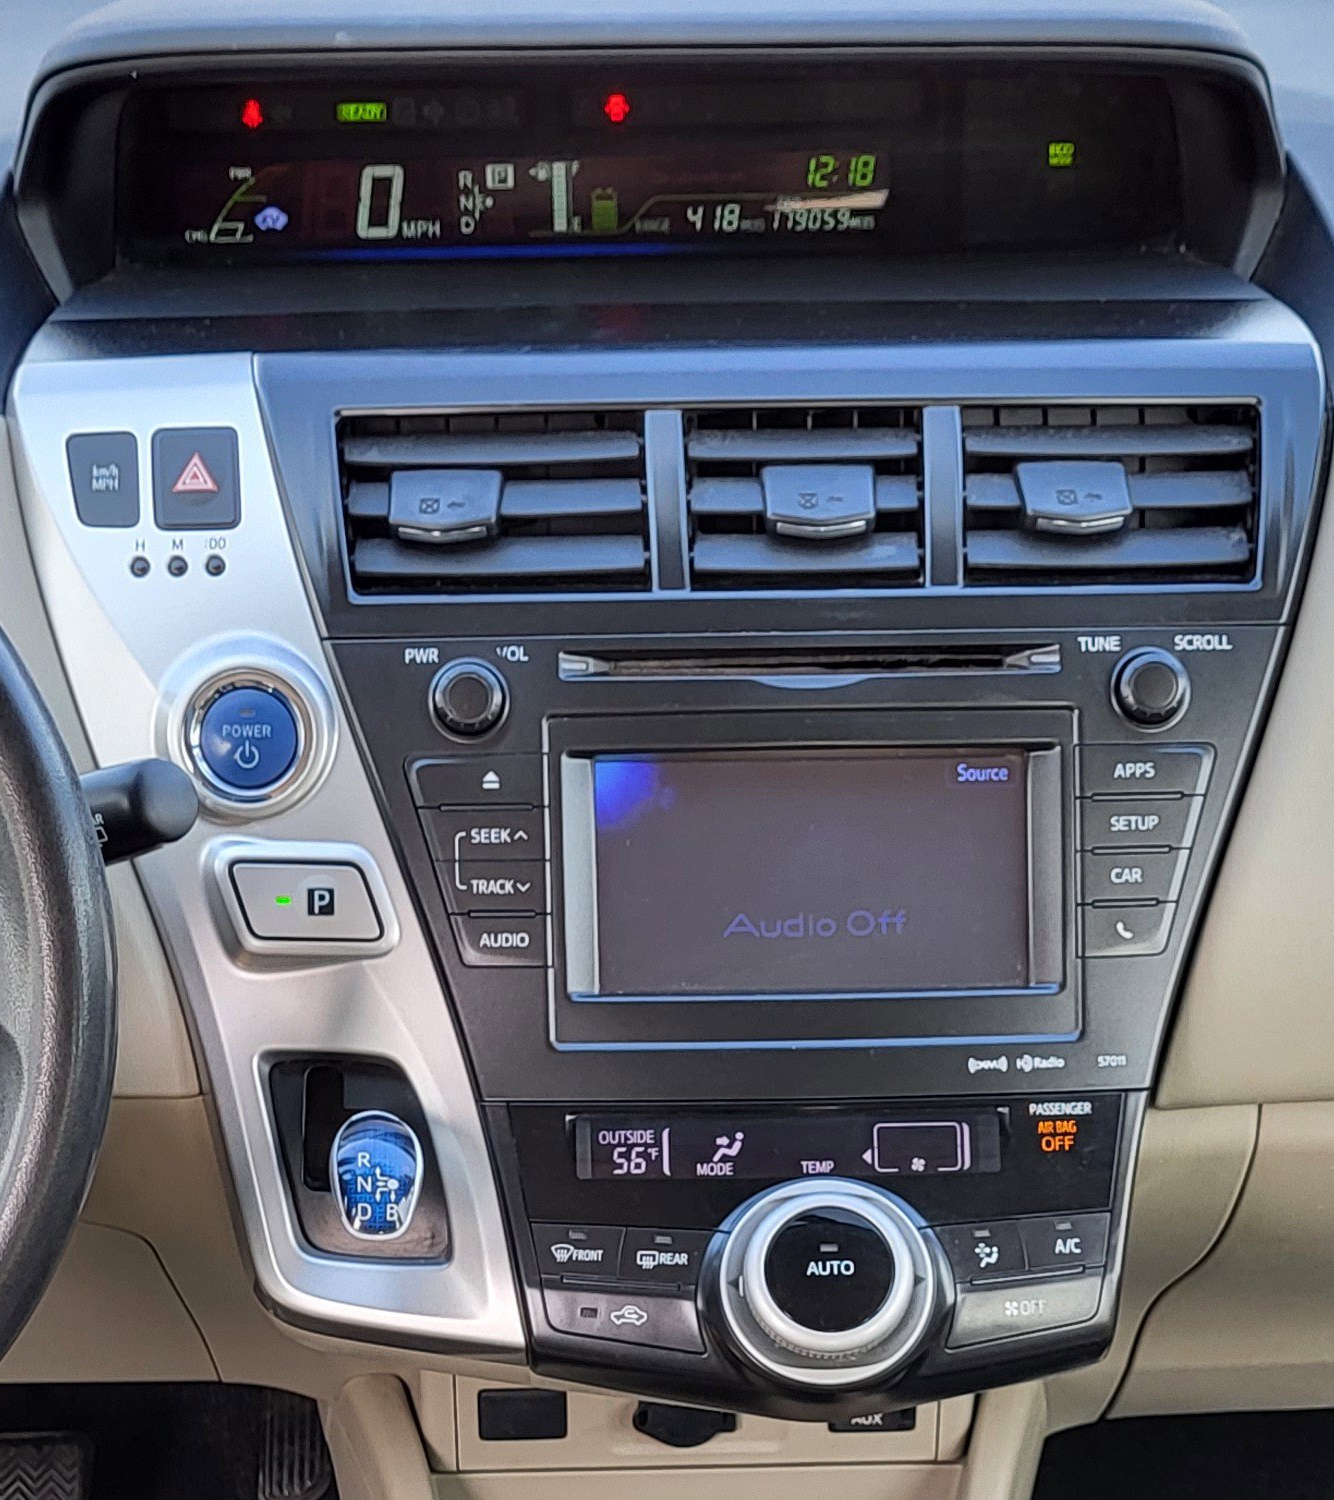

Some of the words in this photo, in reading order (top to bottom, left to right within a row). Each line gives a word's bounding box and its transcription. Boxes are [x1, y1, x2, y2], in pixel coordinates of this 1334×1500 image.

[402, 219, 441, 239] MPH
[92, 477, 119, 491] MPH
[135, 539, 145, 551] H
[172, 538, 184, 551] M
[1077, 636, 1121, 652] TUNE
[1174, 635, 1233, 651] SCROLL
[404, 648, 439, 664] PWR
[496, 646, 529, 662] VOL
[222, 724, 272, 739] POWER
[956, 763, 1009, 783] Source
[1114, 762, 1156, 778] APPS
[1110, 816, 1159, 831] SETUP
[470, 828, 511, 844] SEEK
[1110, 868, 1143, 883] CAR
[470, 879, 515, 895] TRACK
[313, 890, 331, 915] P
[723, 911, 838, 939] Audio
[845, 908, 907, 937] Off
[479, 932, 529, 948] AUDIO
[1028, 1101, 1093, 1116] PASSENGER
[1037, 1121, 1055, 1135] AIR
[1055, 1120, 1077, 1134] BAG
[598, 1130, 655, 1145] OUTSIDE
[1041, 1135, 1075, 1152] OFF
[357, 1152, 371, 1168] R
[800, 1160, 835, 1174] TEMP
[696, 1162, 735, 1176] MODE
[356, 1176, 373, 1193] N
[357, 1203, 372, 1221] D
[386, 1204, 399, 1221] B
[1055, 1238, 1082, 1254] A/C
[572, 1249, 604, 1262] FRONT
[659, 1252, 688, 1266] REAR
[806, 1260, 855, 1276] AUTO
[1019, 1300, 1047, 1315] OFF
